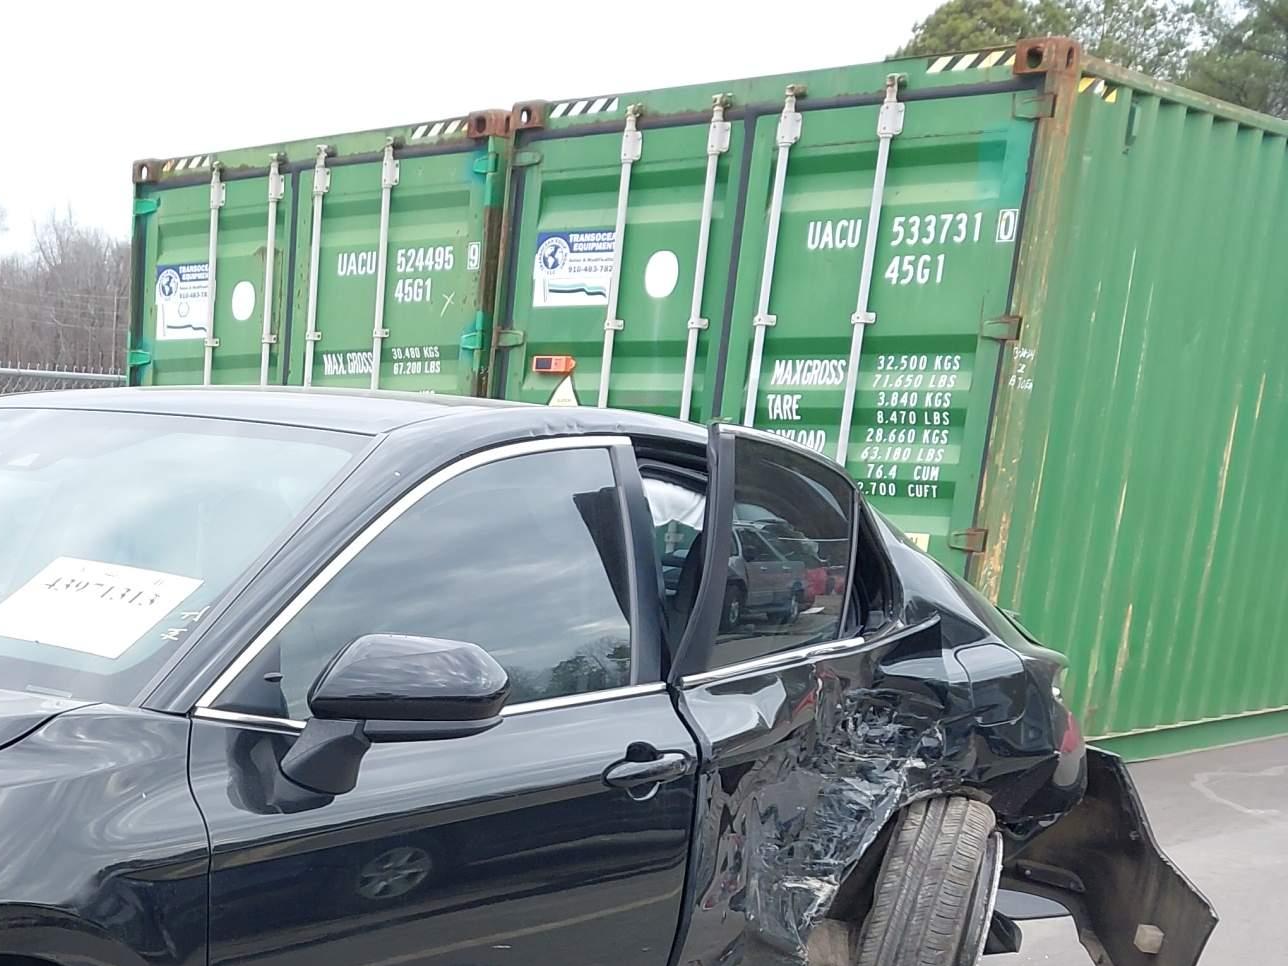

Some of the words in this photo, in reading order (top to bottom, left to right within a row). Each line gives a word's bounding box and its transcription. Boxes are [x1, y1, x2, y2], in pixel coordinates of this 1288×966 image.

[807, 219, 862, 250] UACU
[890, 212, 983, 247] 533731
[997, 210, 1016, 241] 0
[337, 251, 377, 276] UACU
[396, 246, 454, 273] 524495
[469, 243, 479, 269] 9
[884, 254, 945, 285] 45G1
[394, 278, 432, 303] 45G1
[392, 347, 421, 360] 30.480
[423, 346, 440, 359] KGS
[323, 353, 347, 376] MAX.
[347, 352, 374, 375] GROSS
[424, 361, 441, 374] LBS
[876, 355, 928, 371] 32.500
[934, 356, 961, 371] KGS
[872, 374, 923, 389] 71.650
[928, 374, 958, 389] LBS
[767, 394, 802, 420] TARE
[876, 392, 918, 407] 3.840
[924, 392, 952, 408] KGS
[876, 411, 917, 425] 8.470
[924, 412, 950, 426] LBS
[865, 428, 916, 443] 28.660
[922, 429, 949, 445] KGS
[861, 446, 911, 462] 63.180
[916, 447, 945, 462] LBS
[866, 464, 897, 480] 76.4
[913, 466, 940, 481] CUM
[907, 484, 938, 498] CUFT
